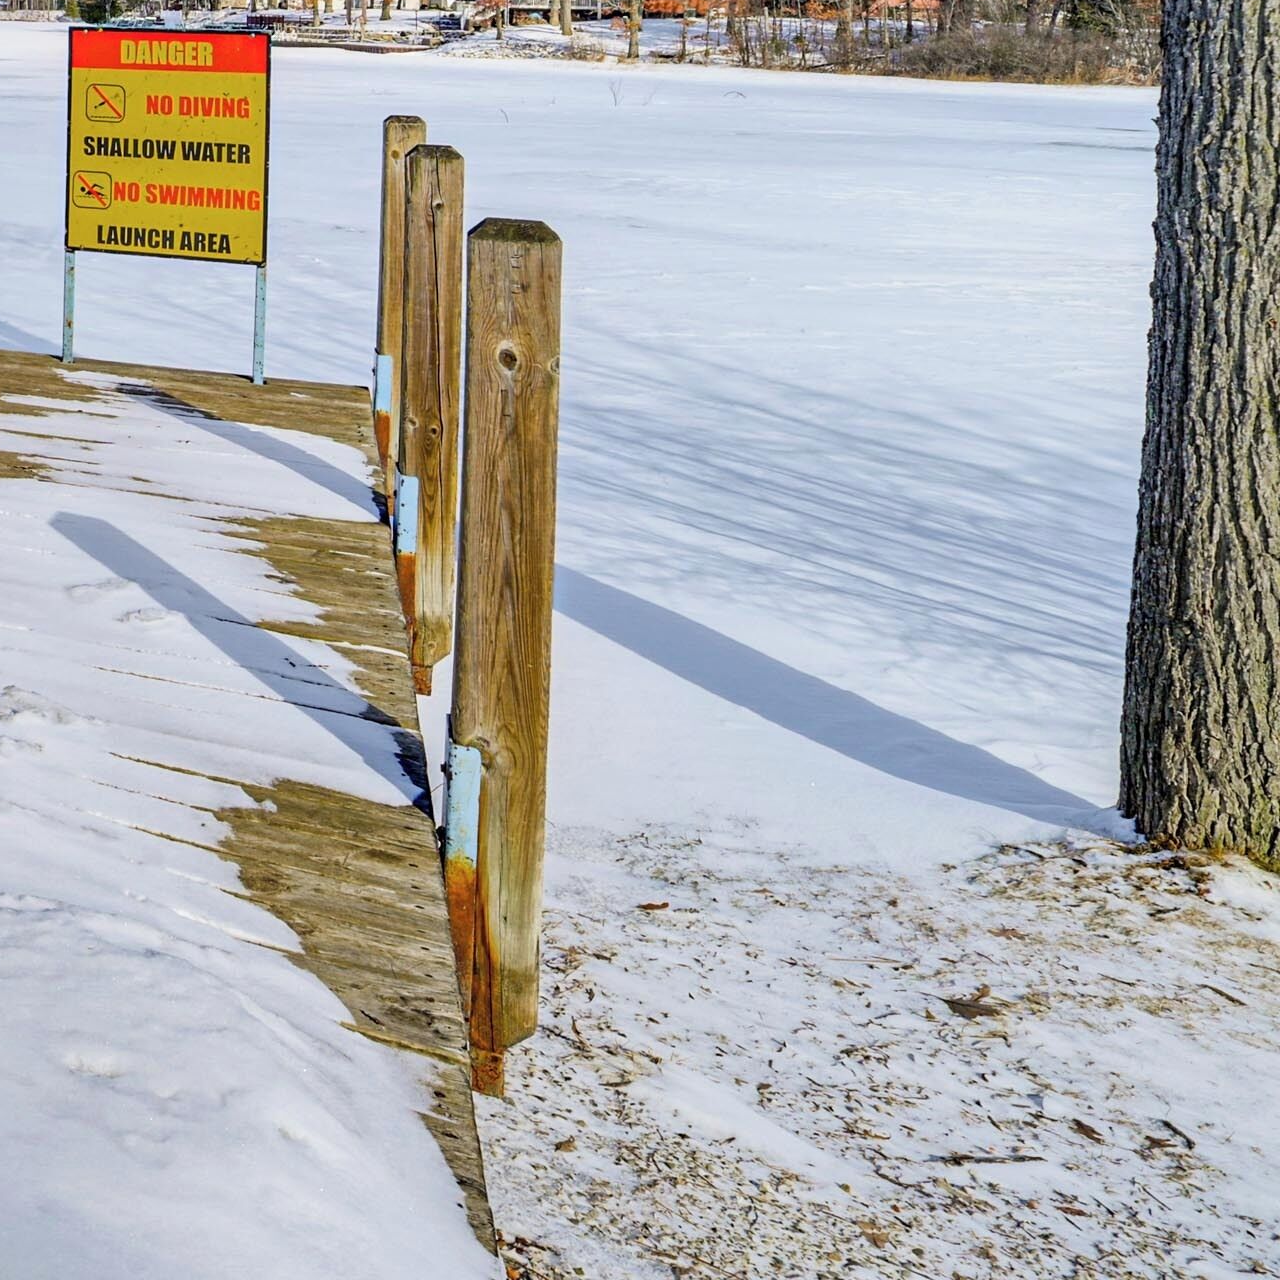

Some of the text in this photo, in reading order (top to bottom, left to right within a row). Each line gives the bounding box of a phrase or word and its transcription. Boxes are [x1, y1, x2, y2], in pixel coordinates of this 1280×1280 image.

[120, 40, 213, 66] DANGER
[146, 95, 251, 119] NO DIVING
[83, 136, 251, 164] SHALLOW WATER
[114, 182, 261, 211] NO SWIMMING
[97, 225, 231, 254] LAUNCH AREA
